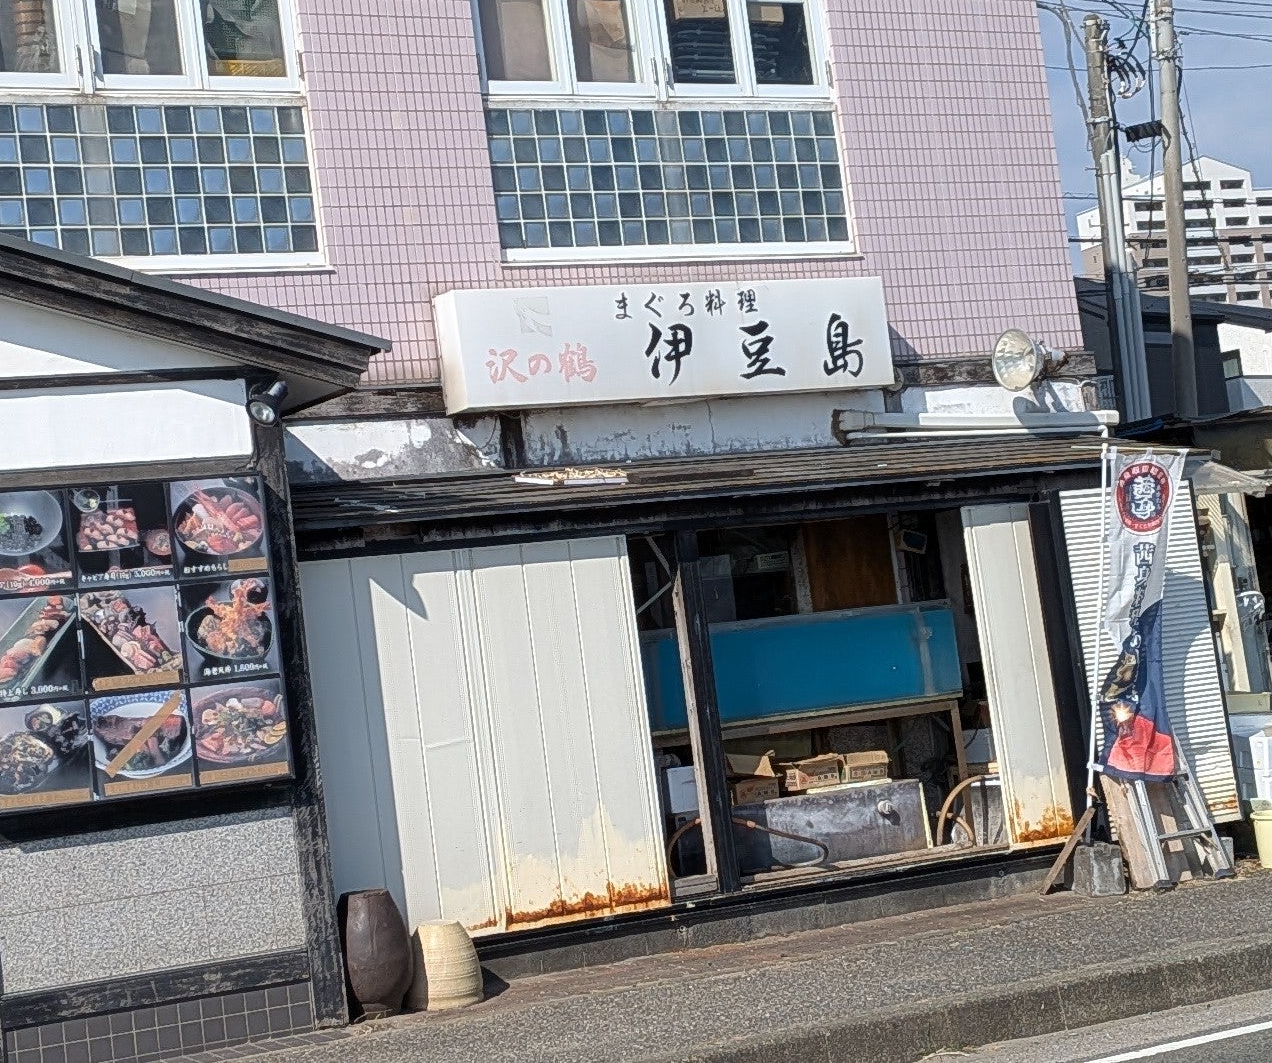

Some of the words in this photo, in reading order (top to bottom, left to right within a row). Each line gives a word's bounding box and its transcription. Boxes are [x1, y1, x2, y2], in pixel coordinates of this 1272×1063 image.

[614, 289, 759, 320] まぐろ料理
[485, 342, 598, 385] 沢の鶴
[644, 313, 864, 386] 伊豆島
